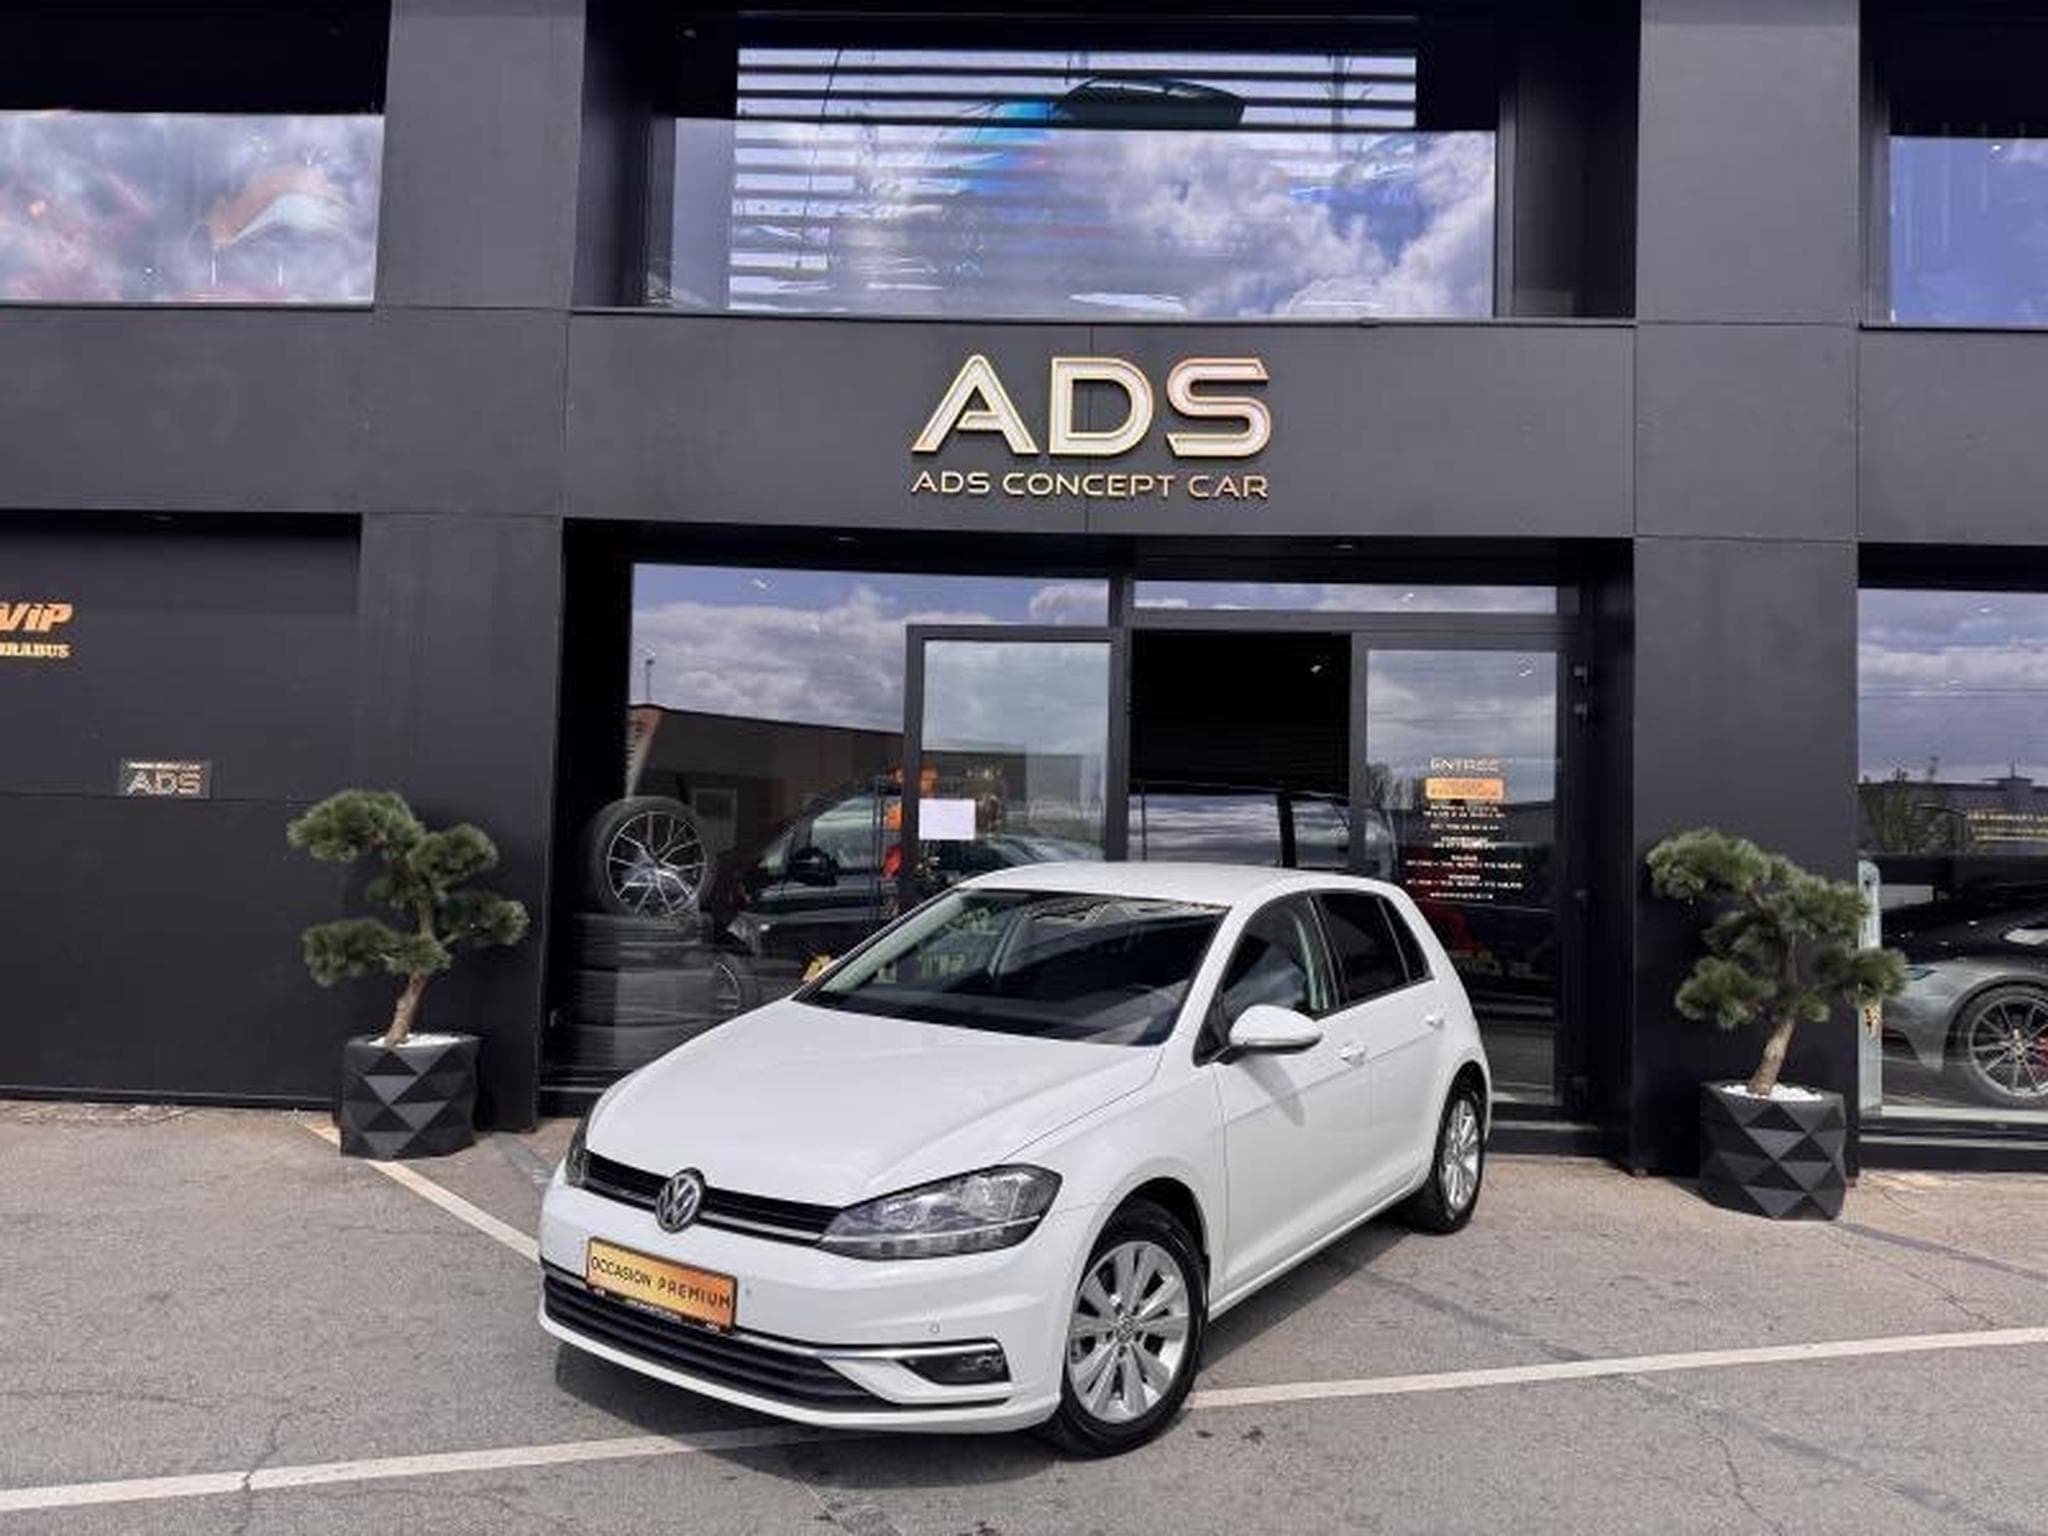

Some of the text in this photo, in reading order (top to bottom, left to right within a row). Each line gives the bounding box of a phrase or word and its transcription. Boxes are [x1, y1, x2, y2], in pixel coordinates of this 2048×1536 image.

[911, 354, 1271, 457] ADS
[911, 471, 1269, 498] ADS CONCEPT CAR
[127, 771, 201, 796] ADS
[591, 1256, 731, 1310] OCCASION PREMIUM
